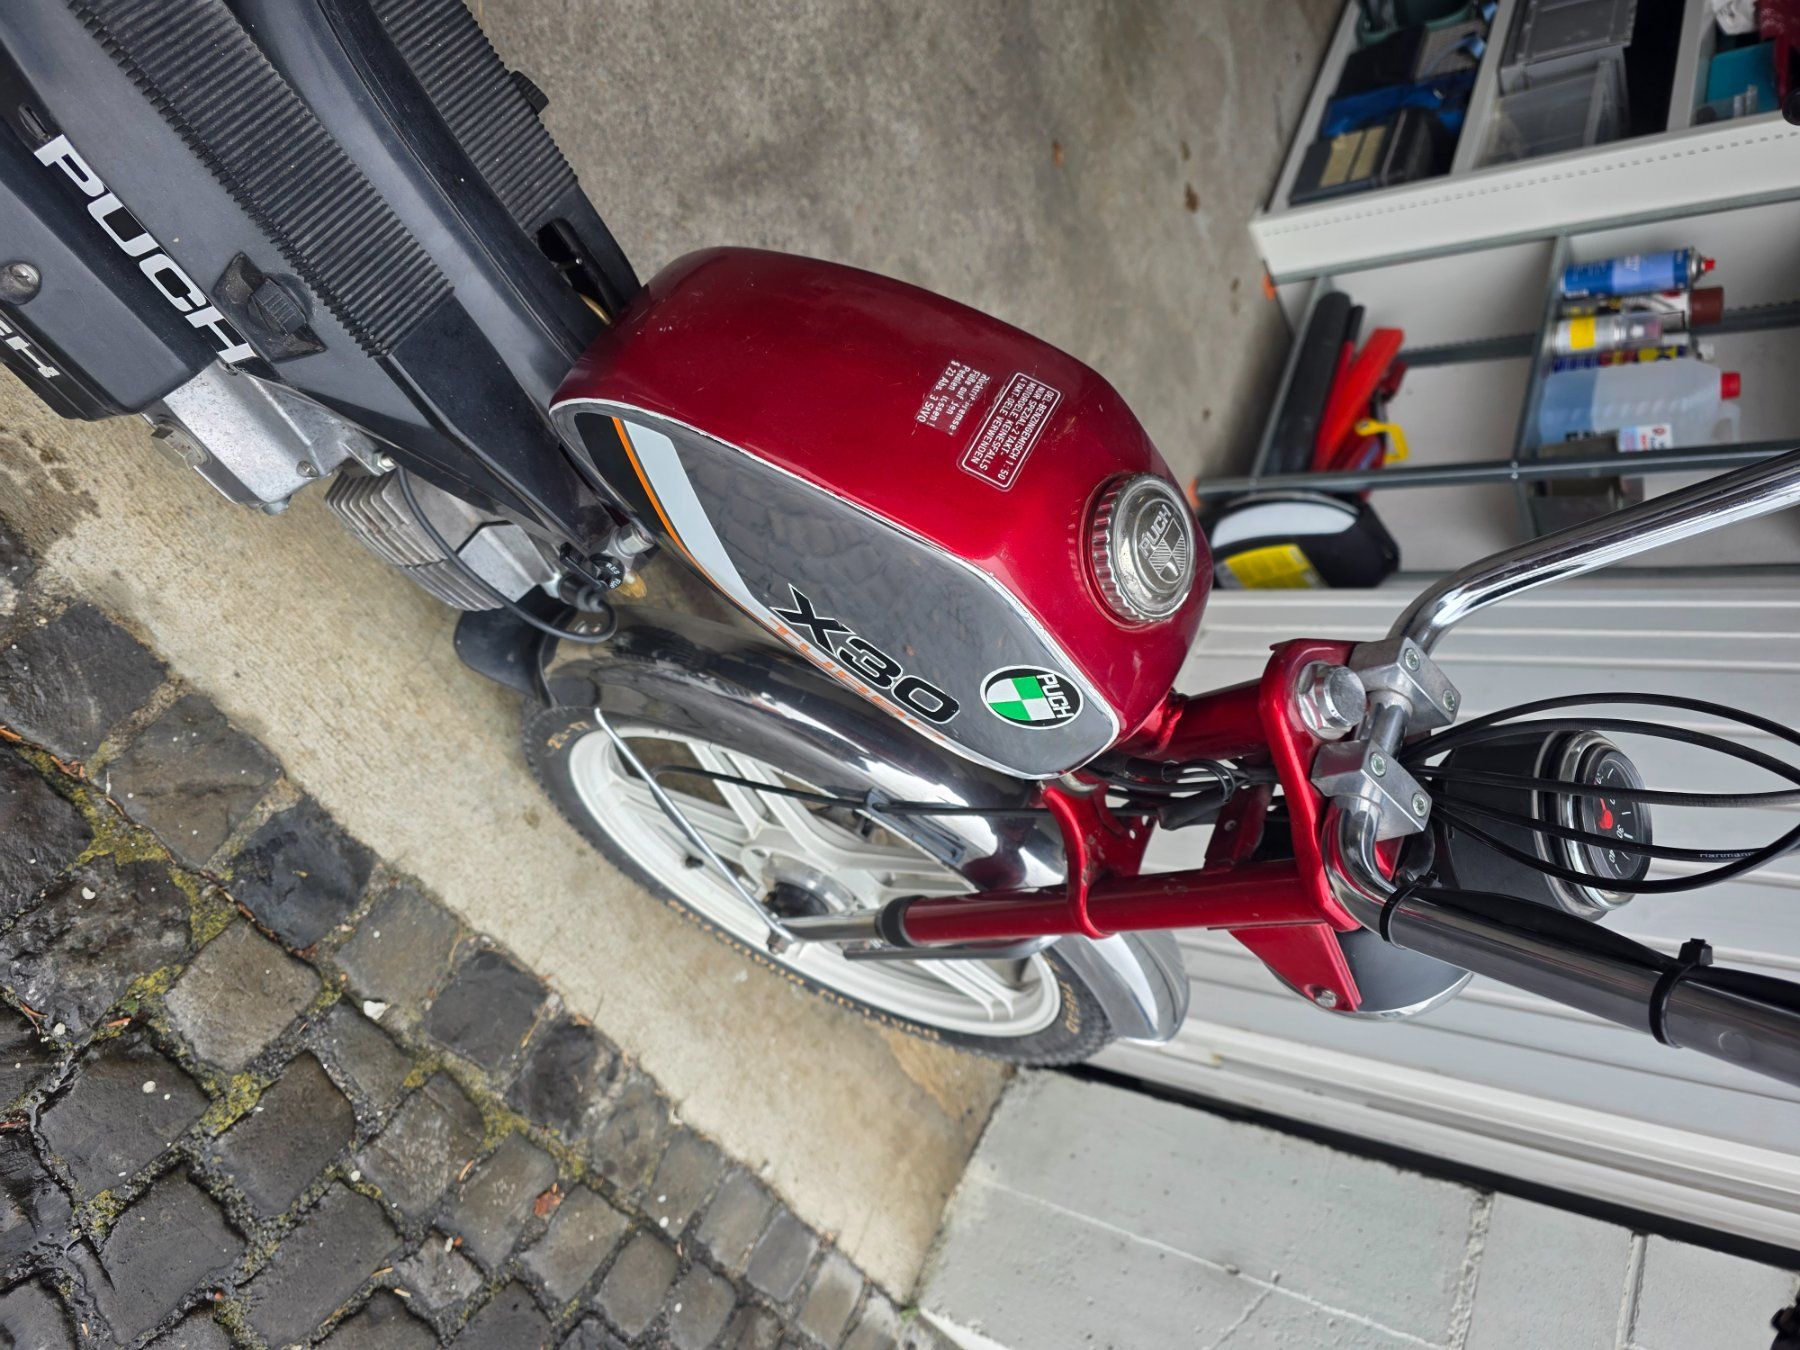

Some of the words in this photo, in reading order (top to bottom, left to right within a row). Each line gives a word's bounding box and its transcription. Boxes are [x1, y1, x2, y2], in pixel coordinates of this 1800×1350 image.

[34, 134, 257, 363] PUCH
[945, 366, 957, 377] 23
[948, 364, 971, 391] Pedalen
[956, 386, 967, 401] auf
[1035, 386, 1046, 400] NUR
[929, 394, 939, 402] 3
[970, 416, 1005, 464] VERWENDEN
[979, 419, 1014, 471] KEINESFALLS
[1009, 390, 1055, 461] OEL-BENZINGEMISCH
[1138, 504, 1172, 560] PUCH
[769, 583, 960, 724] X30
[1036, 673, 1075, 719] PUCH
[1616, 824, 1625, 839] 30
